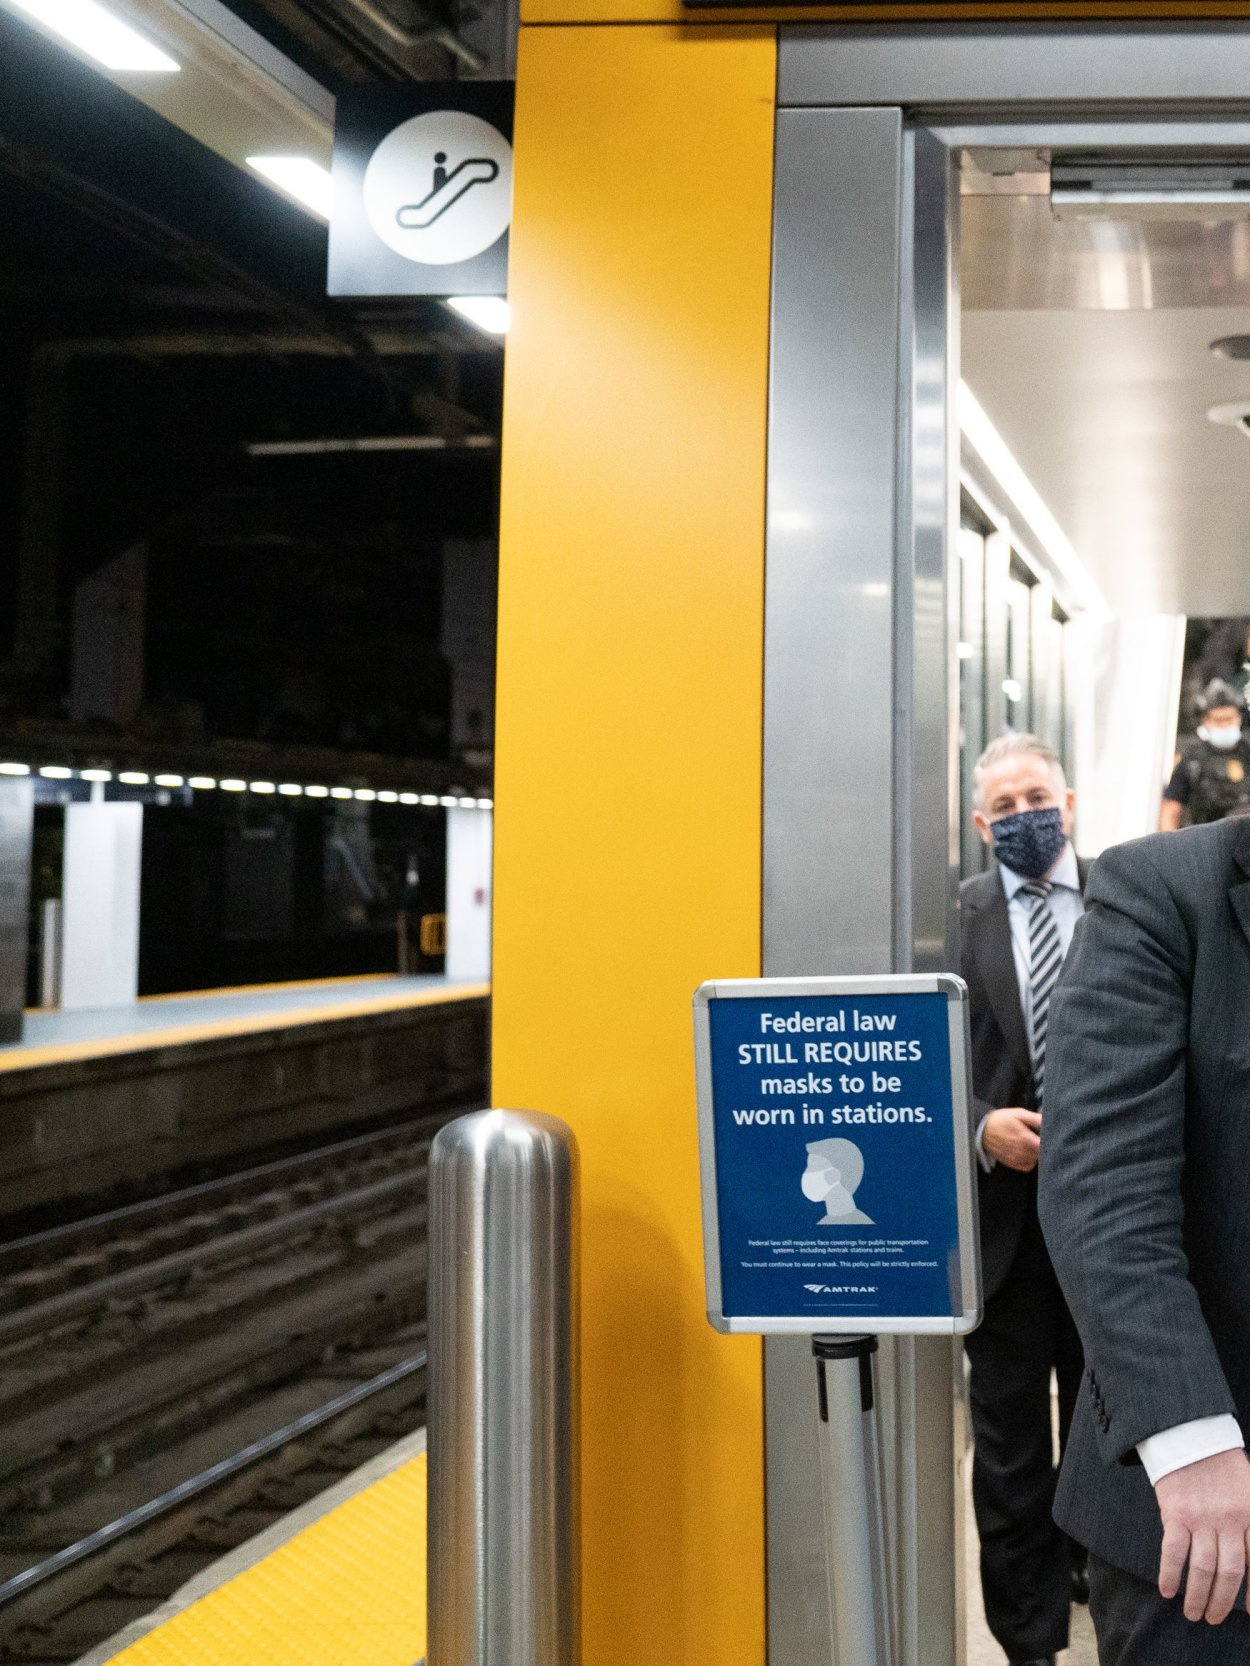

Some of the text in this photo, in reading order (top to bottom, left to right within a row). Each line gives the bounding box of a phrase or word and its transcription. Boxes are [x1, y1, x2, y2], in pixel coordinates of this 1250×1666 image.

[760, 1010, 897, 1033] Federal law
[738, 1040, 922, 1066] STILL REQUIRES
[761, 1071, 902, 1094] masks to be
[733, 1102, 933, 1125] worn in stations.
